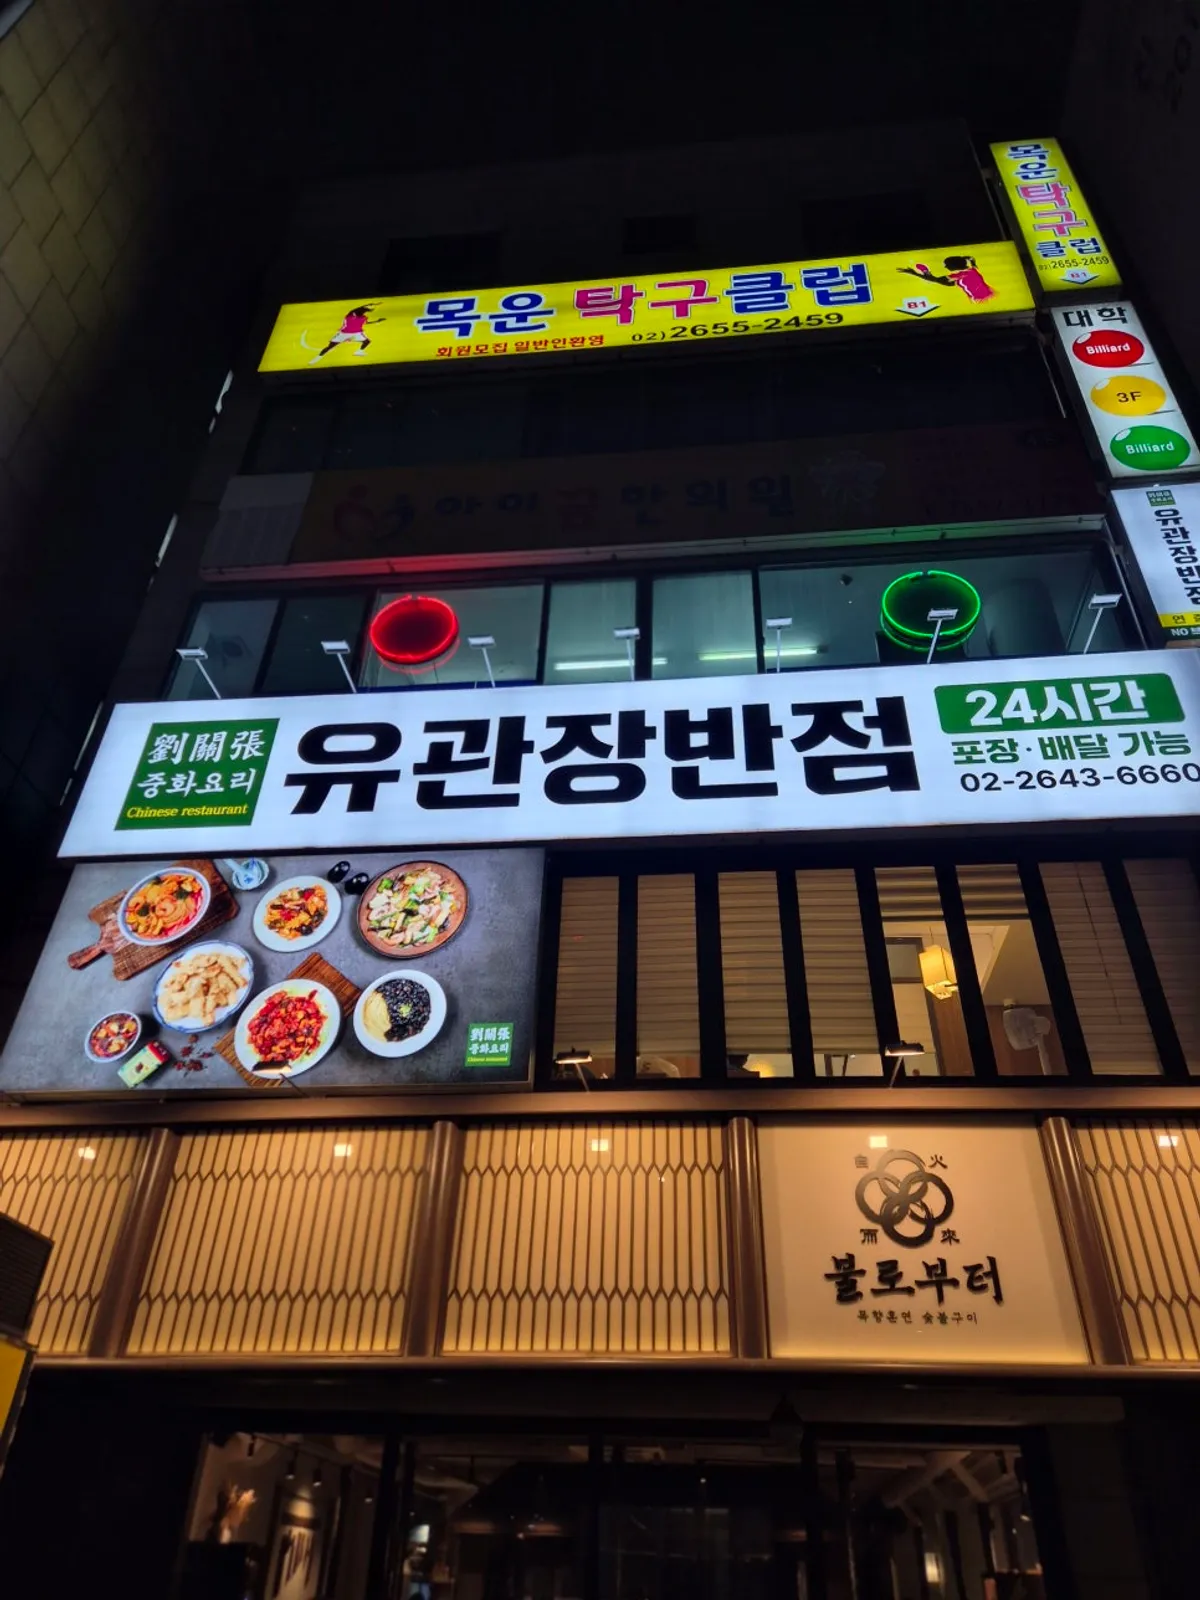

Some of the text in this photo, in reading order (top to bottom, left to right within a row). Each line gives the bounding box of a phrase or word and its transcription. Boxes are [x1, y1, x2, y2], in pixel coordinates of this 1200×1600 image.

[1036, 237, 1101, 258] 클럽
[415, 291, 556, 339] 목운
[906, 300, 926, 309] B1
[1063, 307, 1128, 329] 대학
[435, 334, 605, 358] 회원모집 일반인환영
[1085, 341, 1131, 355] Billiard
[1116, 391, 1142, 404] 3F
[1125, 441, 1175, 455] Billiard
[965, 680, 1150, 727] 24시간
[147, 729, 267, 766] 劉關張
[283, 695, 921, 815] 유관장반점
[1118, 730, 1192, 757] 가능
[136, 768, 258, 799] 중화요리
[960, 762, 1200, 792] 02-2643-6660
[126, 803, 249, 819] Chinese restaurant
[928, 1154, 948, 1169] 火
[824, 1253, 1004, 1307] 불로부터
